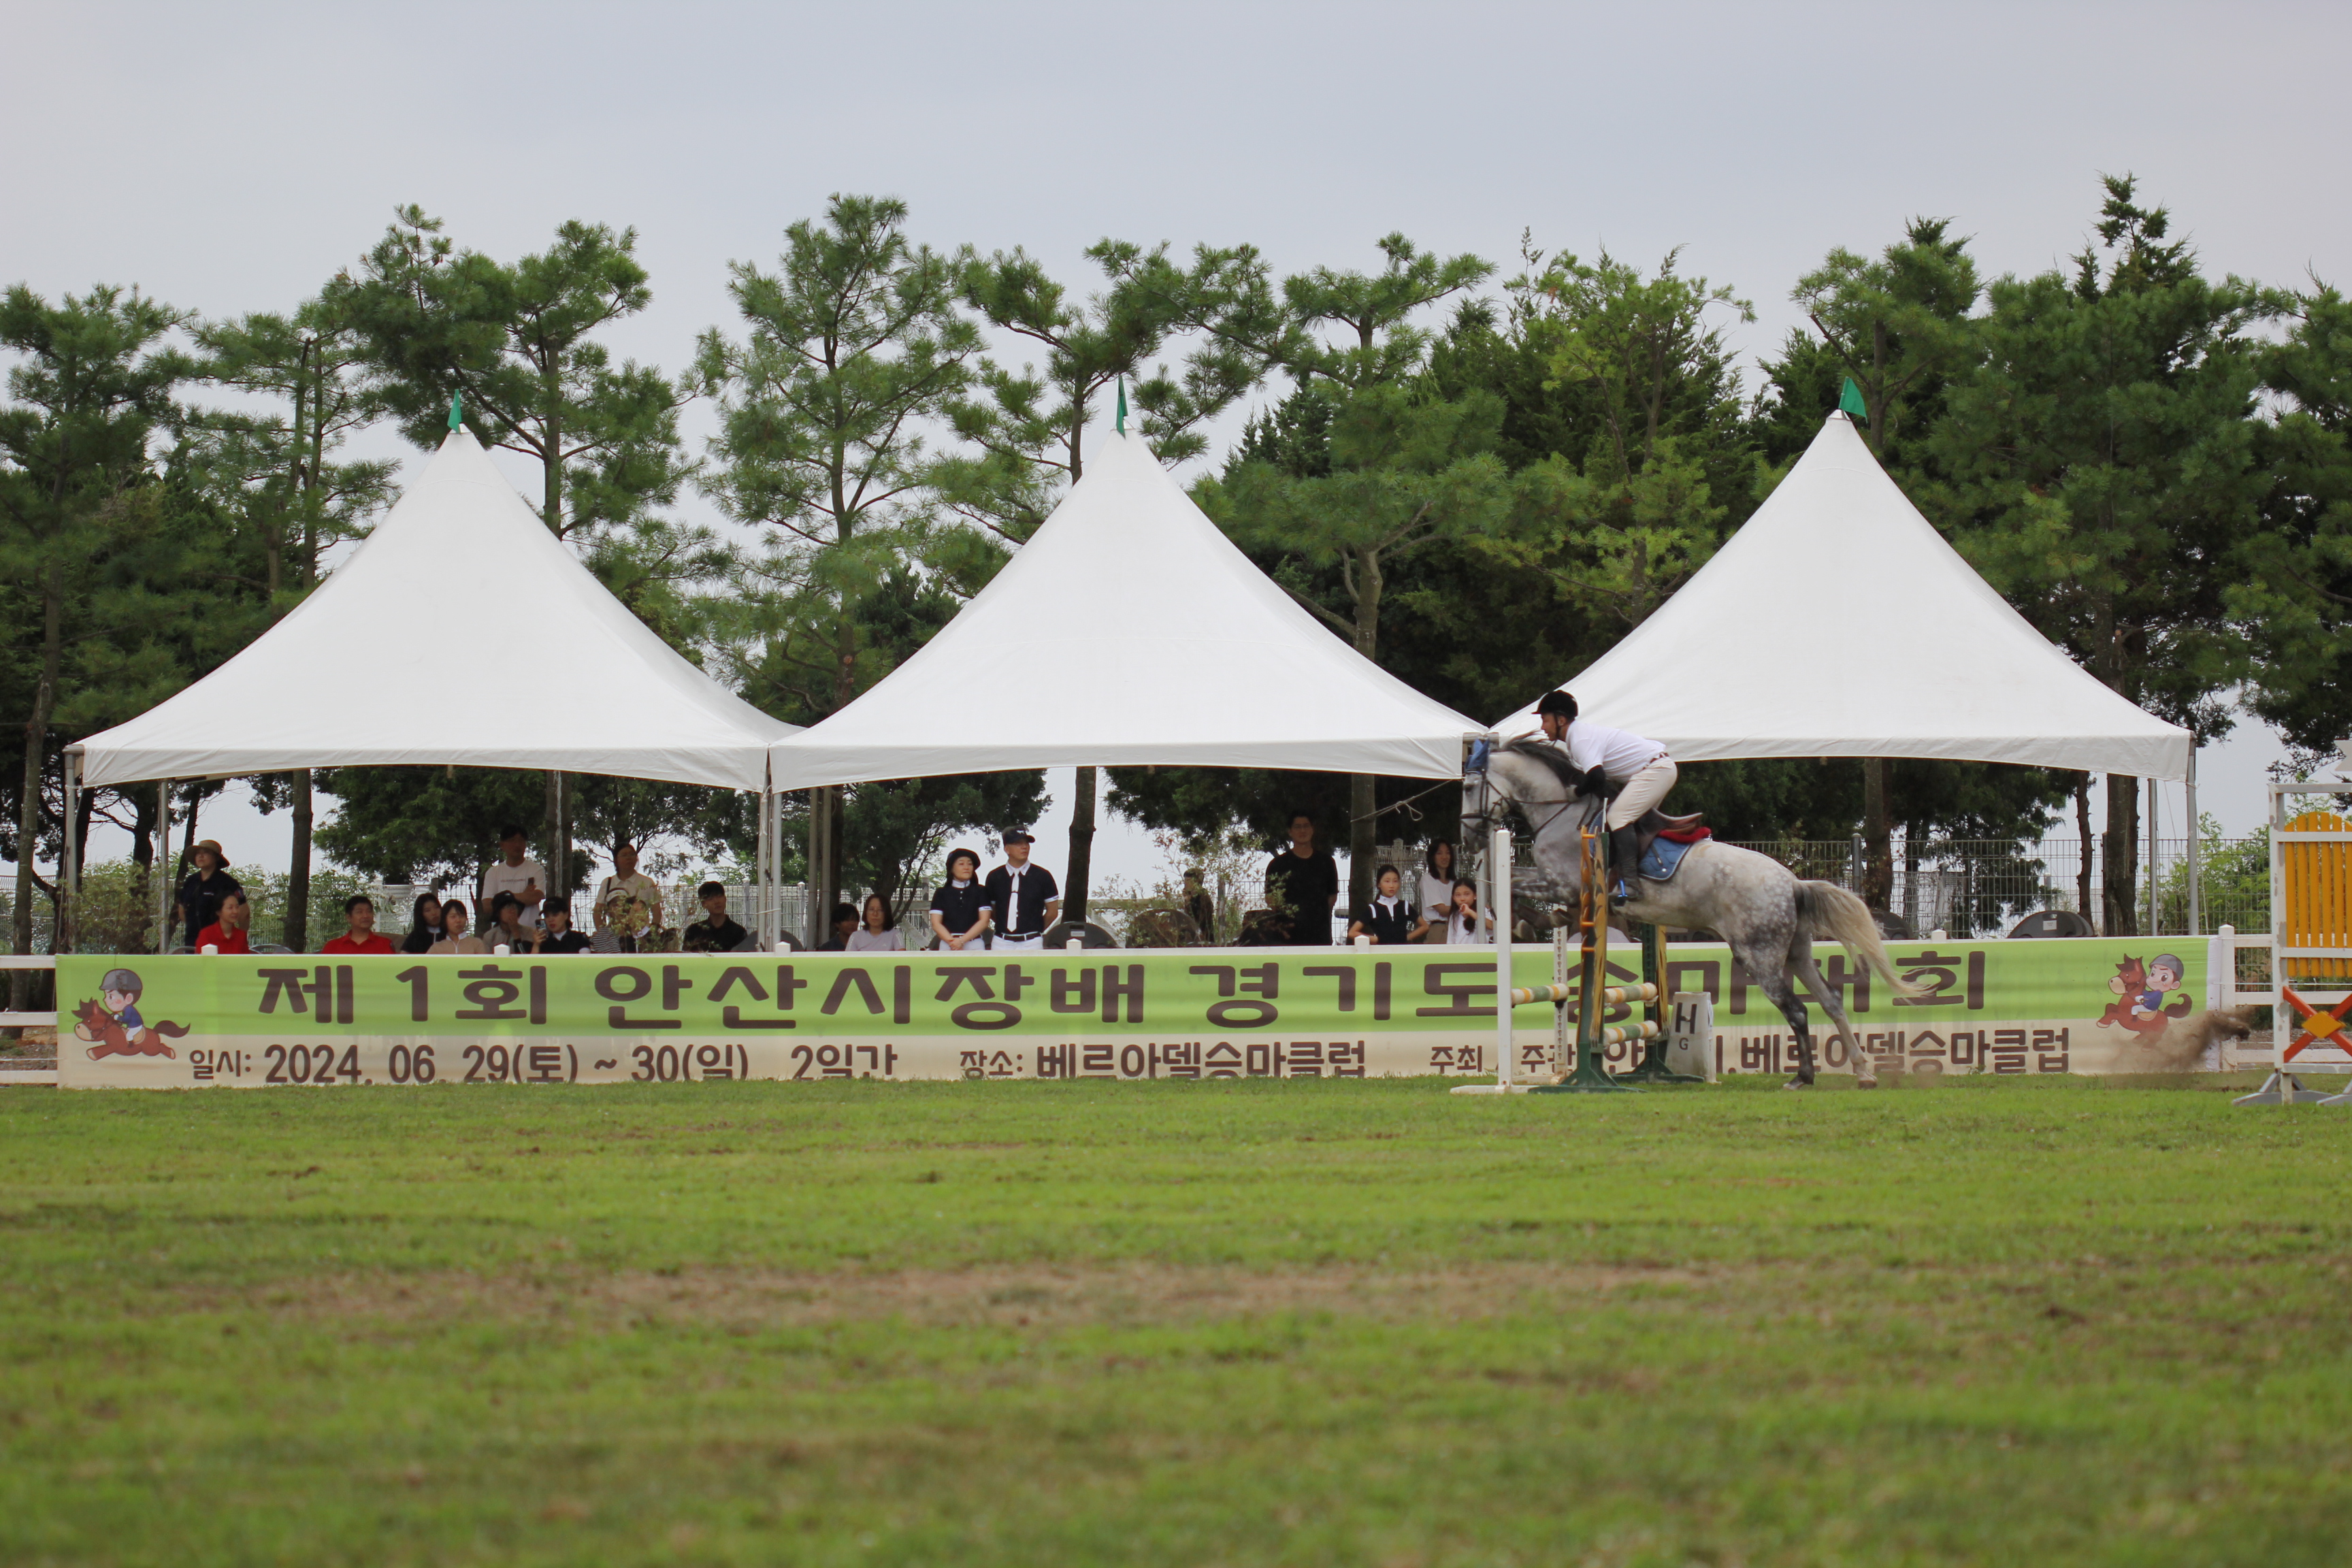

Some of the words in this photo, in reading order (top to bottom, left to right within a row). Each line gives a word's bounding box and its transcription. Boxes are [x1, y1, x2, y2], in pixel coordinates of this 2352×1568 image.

[594, 964, 1145, 1031] 안산시장배
[1188, 962, 1499, 1029] 경기도
[1675, 1002, 1697, 1034] H
[960, 1050, 1023, 1079] 장소:
[1036, 1041, 1365, 1078] 베르아델승마클럽
[1679, 1037, 1689, 1050] G
[189, 1049, 251, 1080] 일시:
[264, 1044, 373, 1085] 2024.
